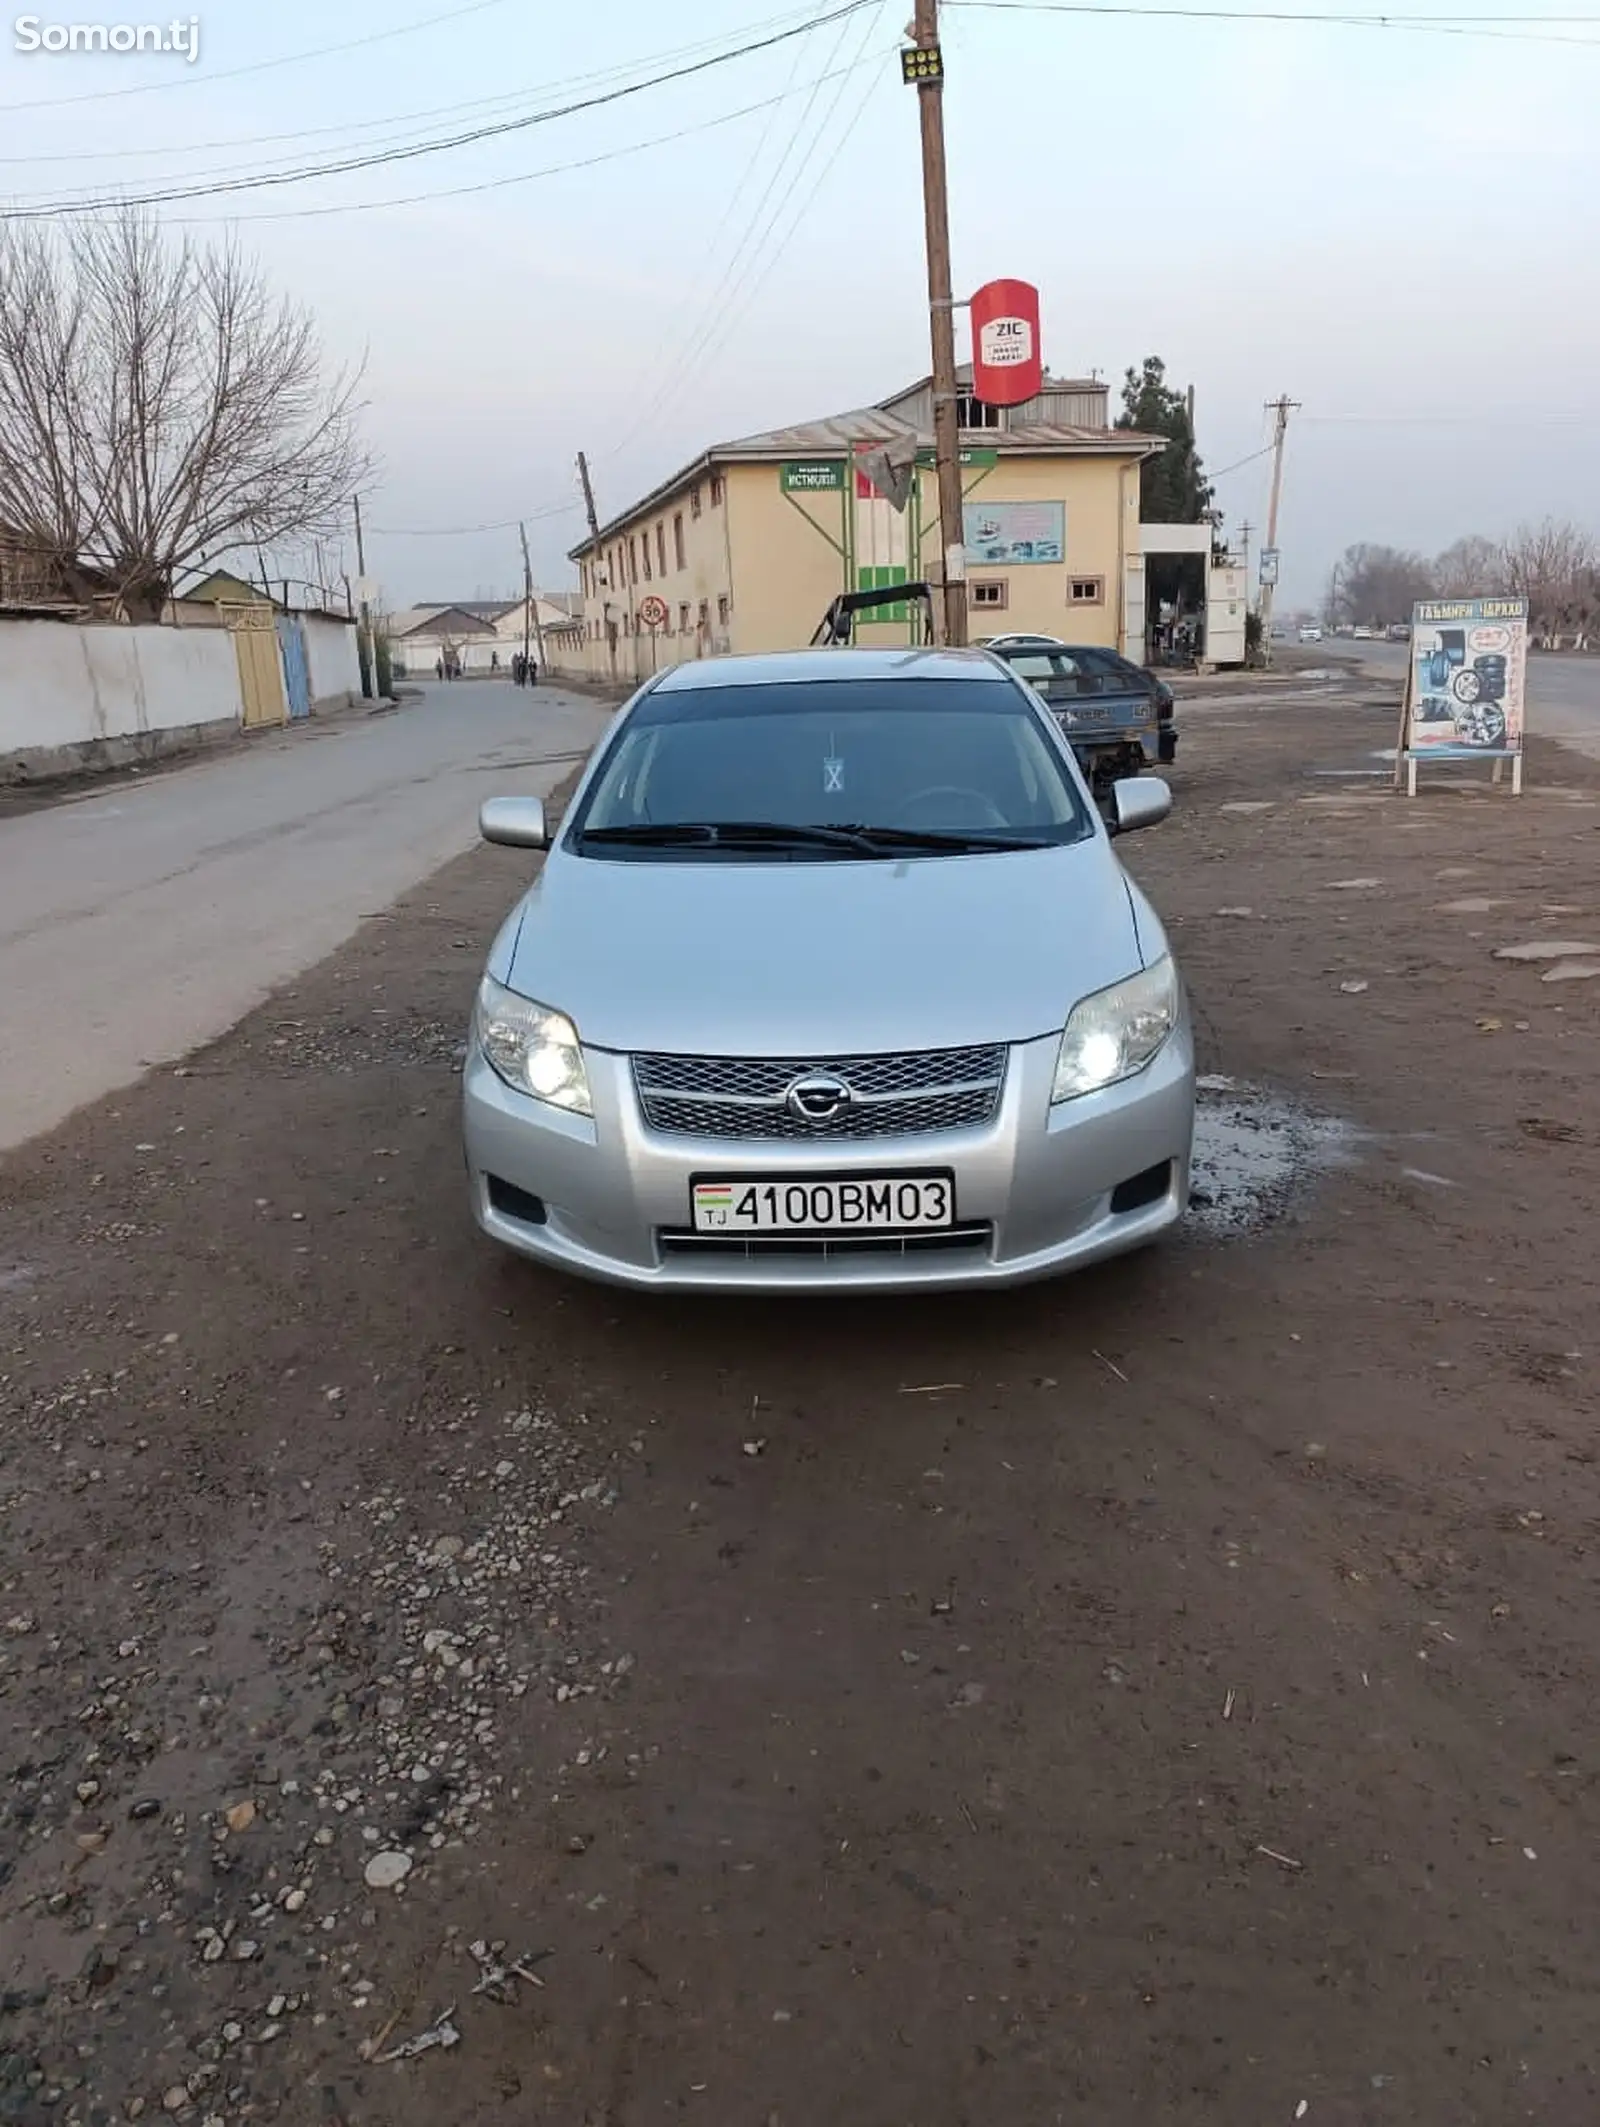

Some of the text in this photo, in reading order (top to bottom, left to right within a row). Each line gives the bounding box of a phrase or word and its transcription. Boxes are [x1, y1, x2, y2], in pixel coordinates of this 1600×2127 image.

[996, 322, 1023, 336] ZIC
[704, 1183, 946, 1225] TJ 4100BM03
